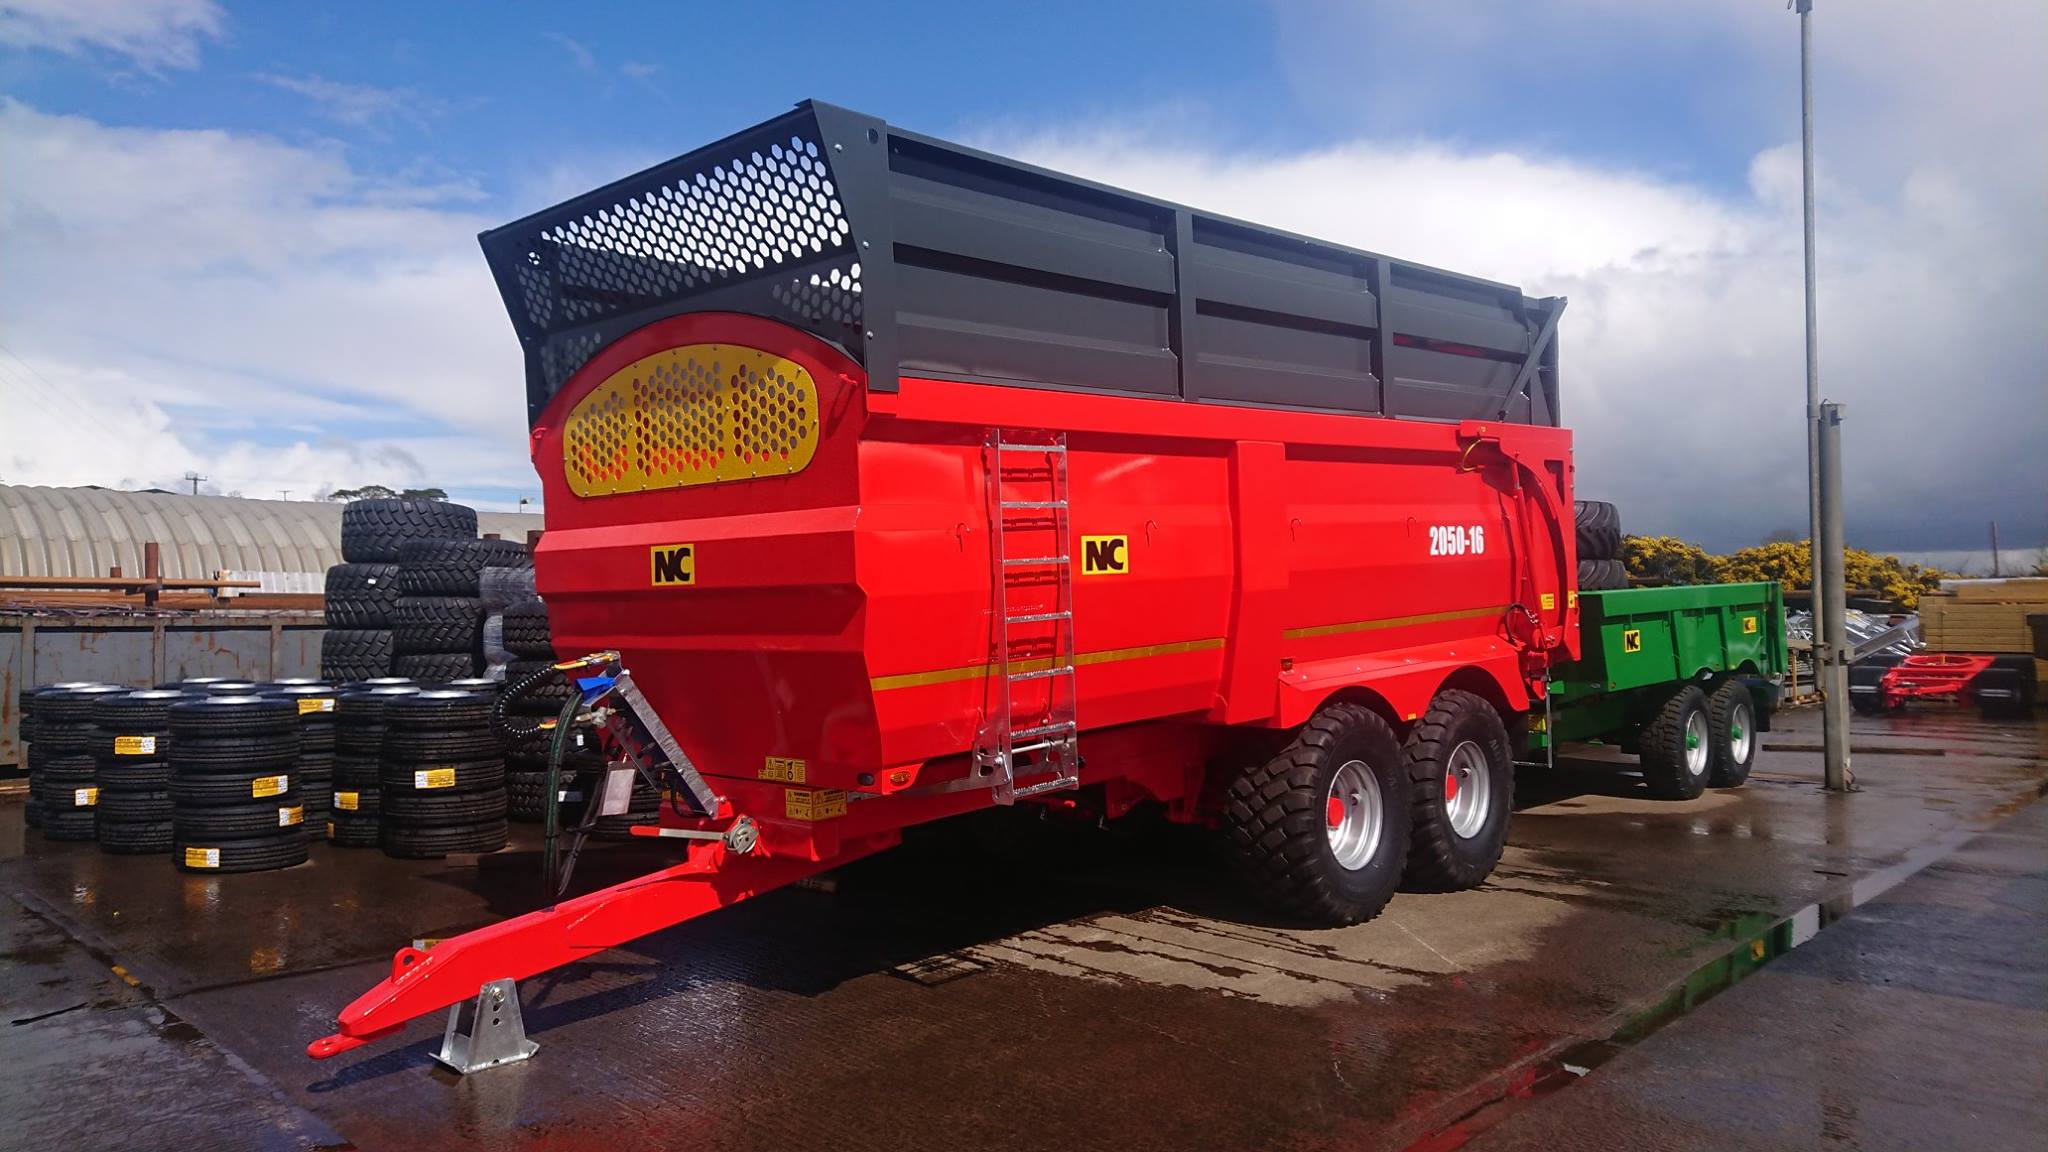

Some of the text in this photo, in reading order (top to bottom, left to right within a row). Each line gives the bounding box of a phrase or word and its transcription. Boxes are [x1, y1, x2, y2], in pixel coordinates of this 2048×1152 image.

[1086, 538, 1124, 571] NC
[1430, 525, 1485, 556] 2050-16
[655, 547, 691, 583] NC
[1626, 631, 1639, 651] NC
